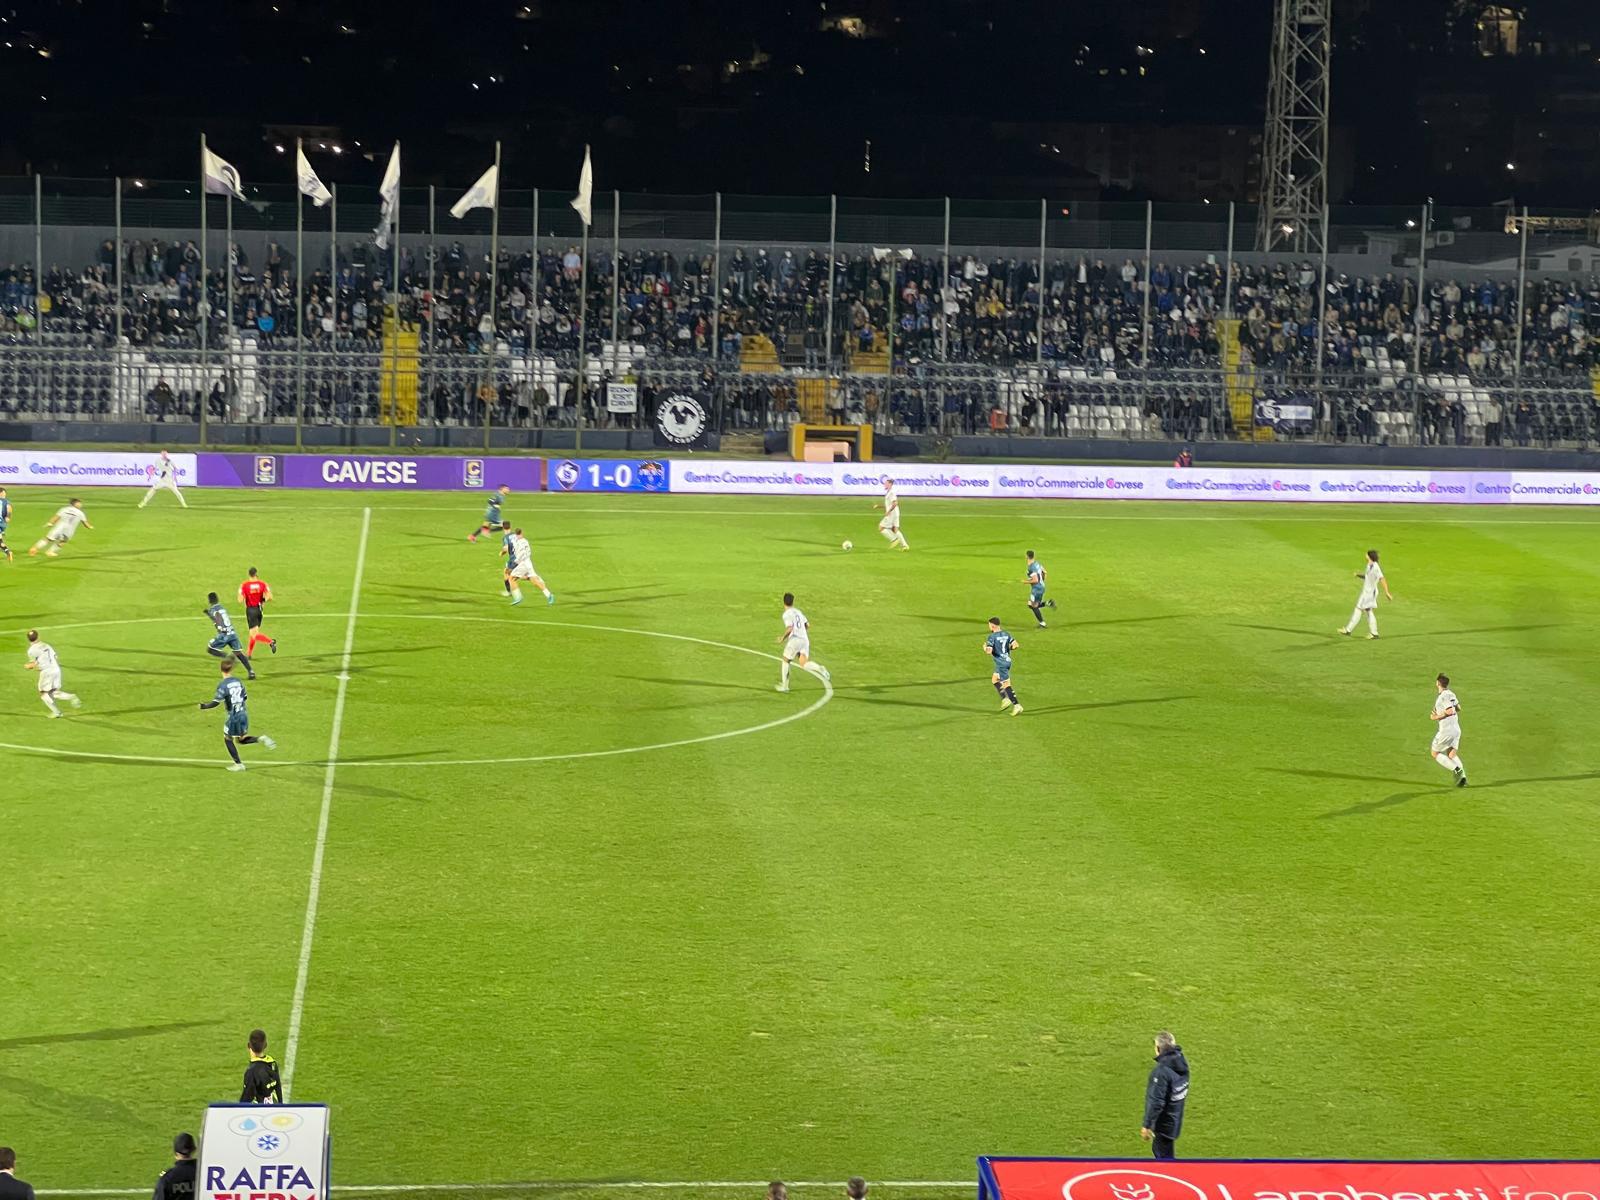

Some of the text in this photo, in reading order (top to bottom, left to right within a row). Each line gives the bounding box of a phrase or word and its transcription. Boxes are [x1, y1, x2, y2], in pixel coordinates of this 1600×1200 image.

[29, 462, 68, 475] Centro
[69, 463, 144, 476] Commerciale
[322, 459, 418, 484] CAVESE
[588, 464, 632, 488] 1-0
[684, 470, 833, 486] Centro Commerciale Cavese
[842, 474, 879, 486] Centro
[951, 475, 990, 488] Cavese
[999, 475, 1144, 490] Centro Commerciale Cavese
[1166, 478, 1312, 492] Centro Commerciale Cavese
[1319, 480, 1466, 494] Centro Commerciale Cavese
[1475, 482, 1511, 494] Centro
[1512, 482, 1582, 495] Commerciale
[996, 635, 1009, 654] 7
[206, 1164, 315, 1191] RAFFA
